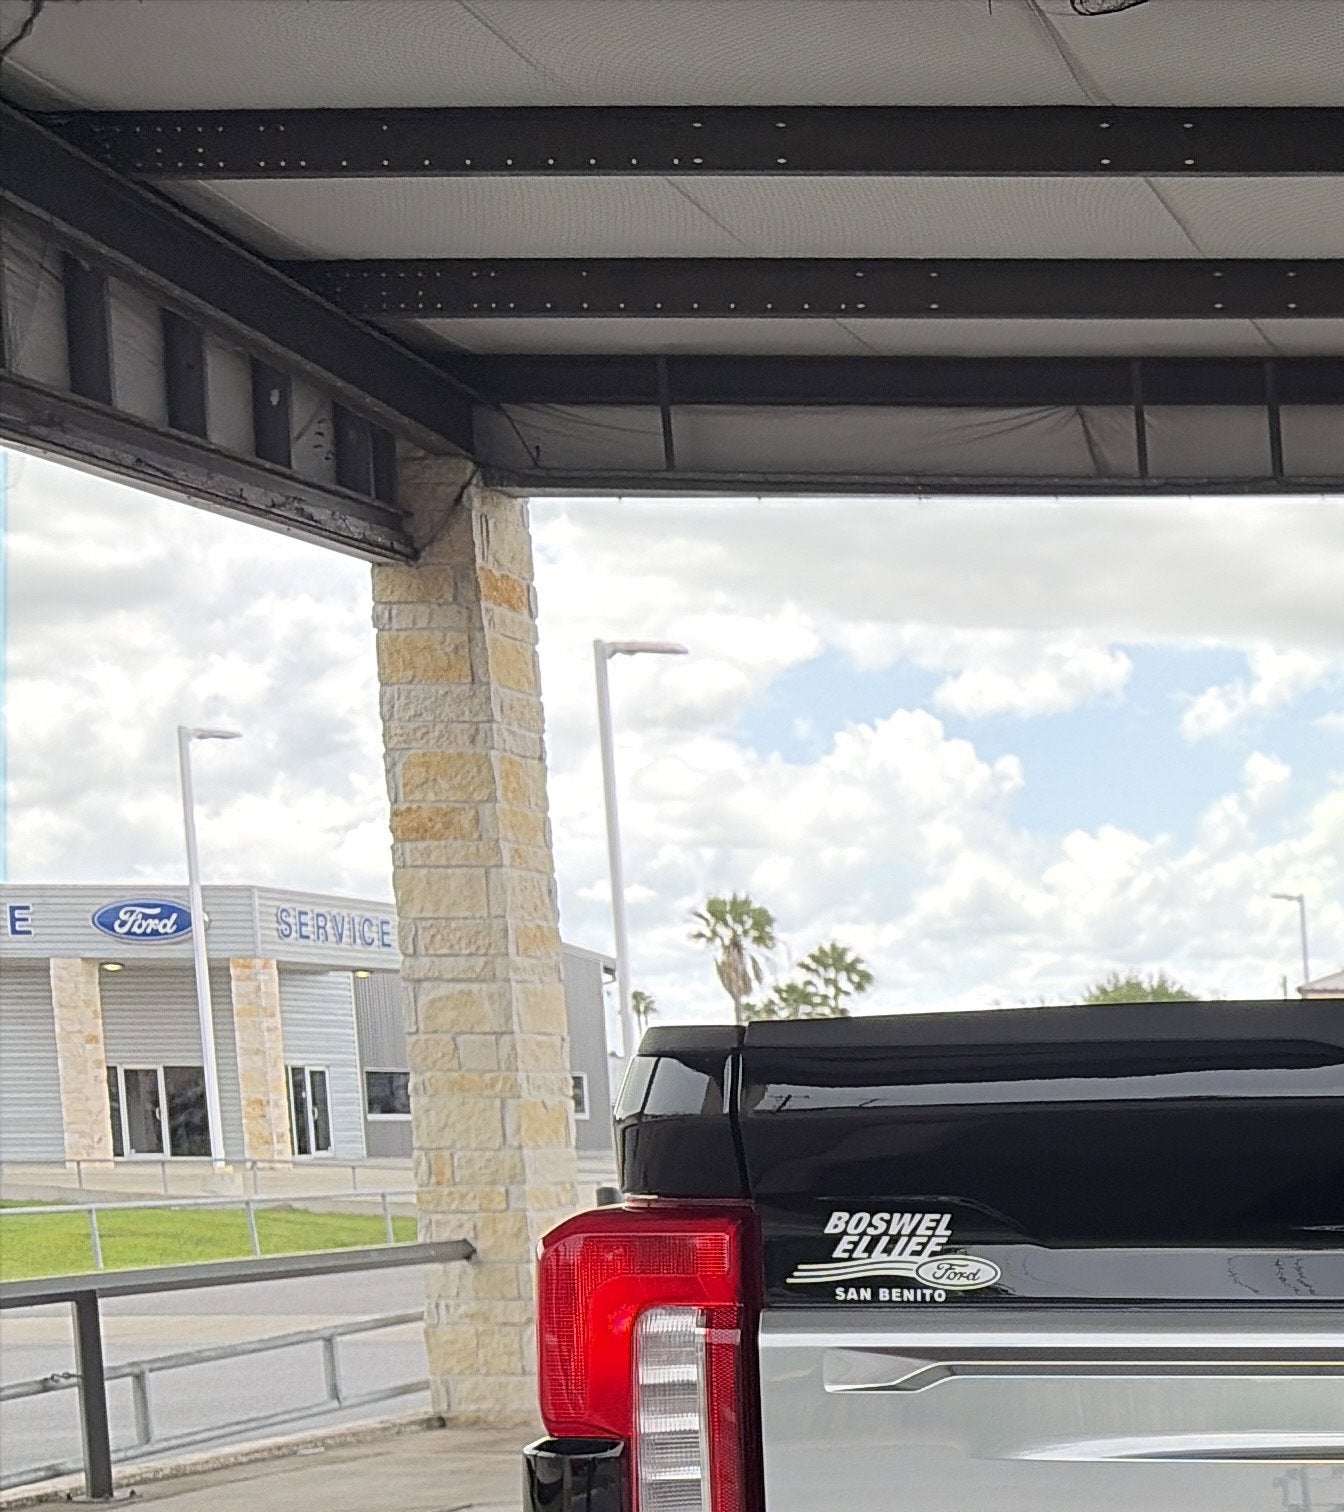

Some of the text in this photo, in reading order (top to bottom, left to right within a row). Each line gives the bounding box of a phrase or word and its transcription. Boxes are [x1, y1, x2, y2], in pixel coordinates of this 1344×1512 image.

[113, 906, 178, 934] Ford
[277, 906, 393, 948] SERVICE
[824, 1211, 952, 1236] BOSWEL
[831, 1235, 948, 1259] ELLIFF
[932, 1262, 980, 1281] Ford
[835, 1287, 946, 1302] SAN BENITO
